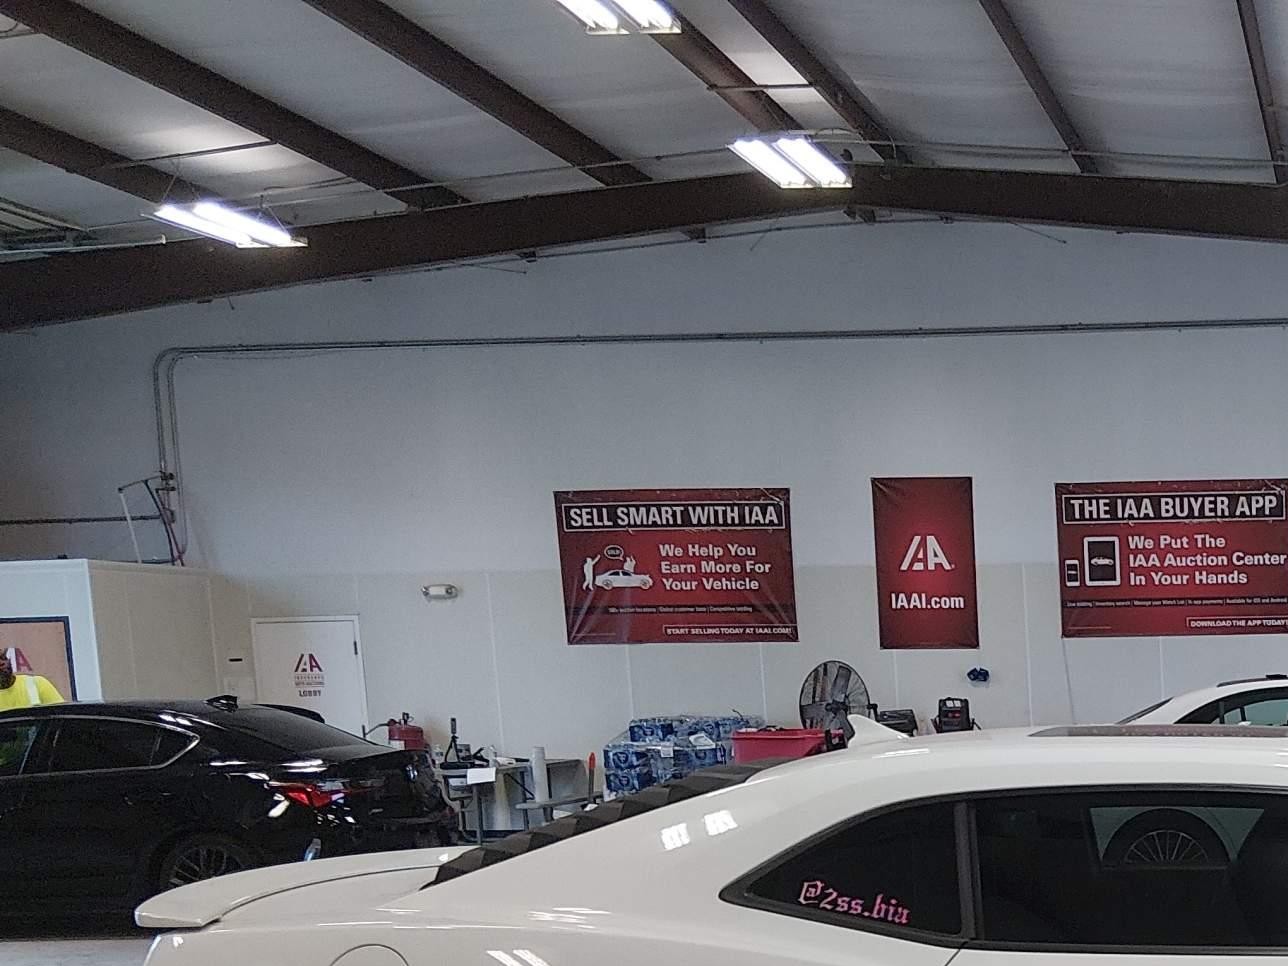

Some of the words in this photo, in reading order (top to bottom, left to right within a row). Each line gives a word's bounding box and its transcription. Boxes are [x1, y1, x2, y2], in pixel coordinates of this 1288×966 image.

[1069, 499, 1111, 519] THE
[1117, 498, 1154, 518] IAA
[1160, 497, 1229, 517] BUYER
[1236, 495, 1278, 516] APP
[569, 507, 613, 527] SELL
[616, 506, 685, 526] SMART
[688, 505, 739, 525] WITH
[744, 504, 779, 525] IAA
[1128, 535, 1154, 549] We
[1160, 535, 1188, 549] Put
[1194, 534, 1226, 548] The
[659, 544, 683, 557] We
[688, 543, 724, 559] Help
[727, 543, 756, 557] You
[661, 561, 697, 574] Earn
[701, 561, 741, 573] More
[746, 560, 771, 573] For
[1129, 554, 1161, 568] IAA
[1163, 552, 1228, 567] Auction
[1231, 552, 1288, 566] Center
[663, 578, 698, 591] Your
[703, 577, 760, 590] Vehicle
[1129, 572, 1146, 586] In
[1150, 571, 1190, 585] Your
[1195, 570, 1248, 584] Hands
[890, 592, 965, 609] IAAI.com
[690, 627, 720, 635] SELLING
[720, 627, 744, 635] TODAY
